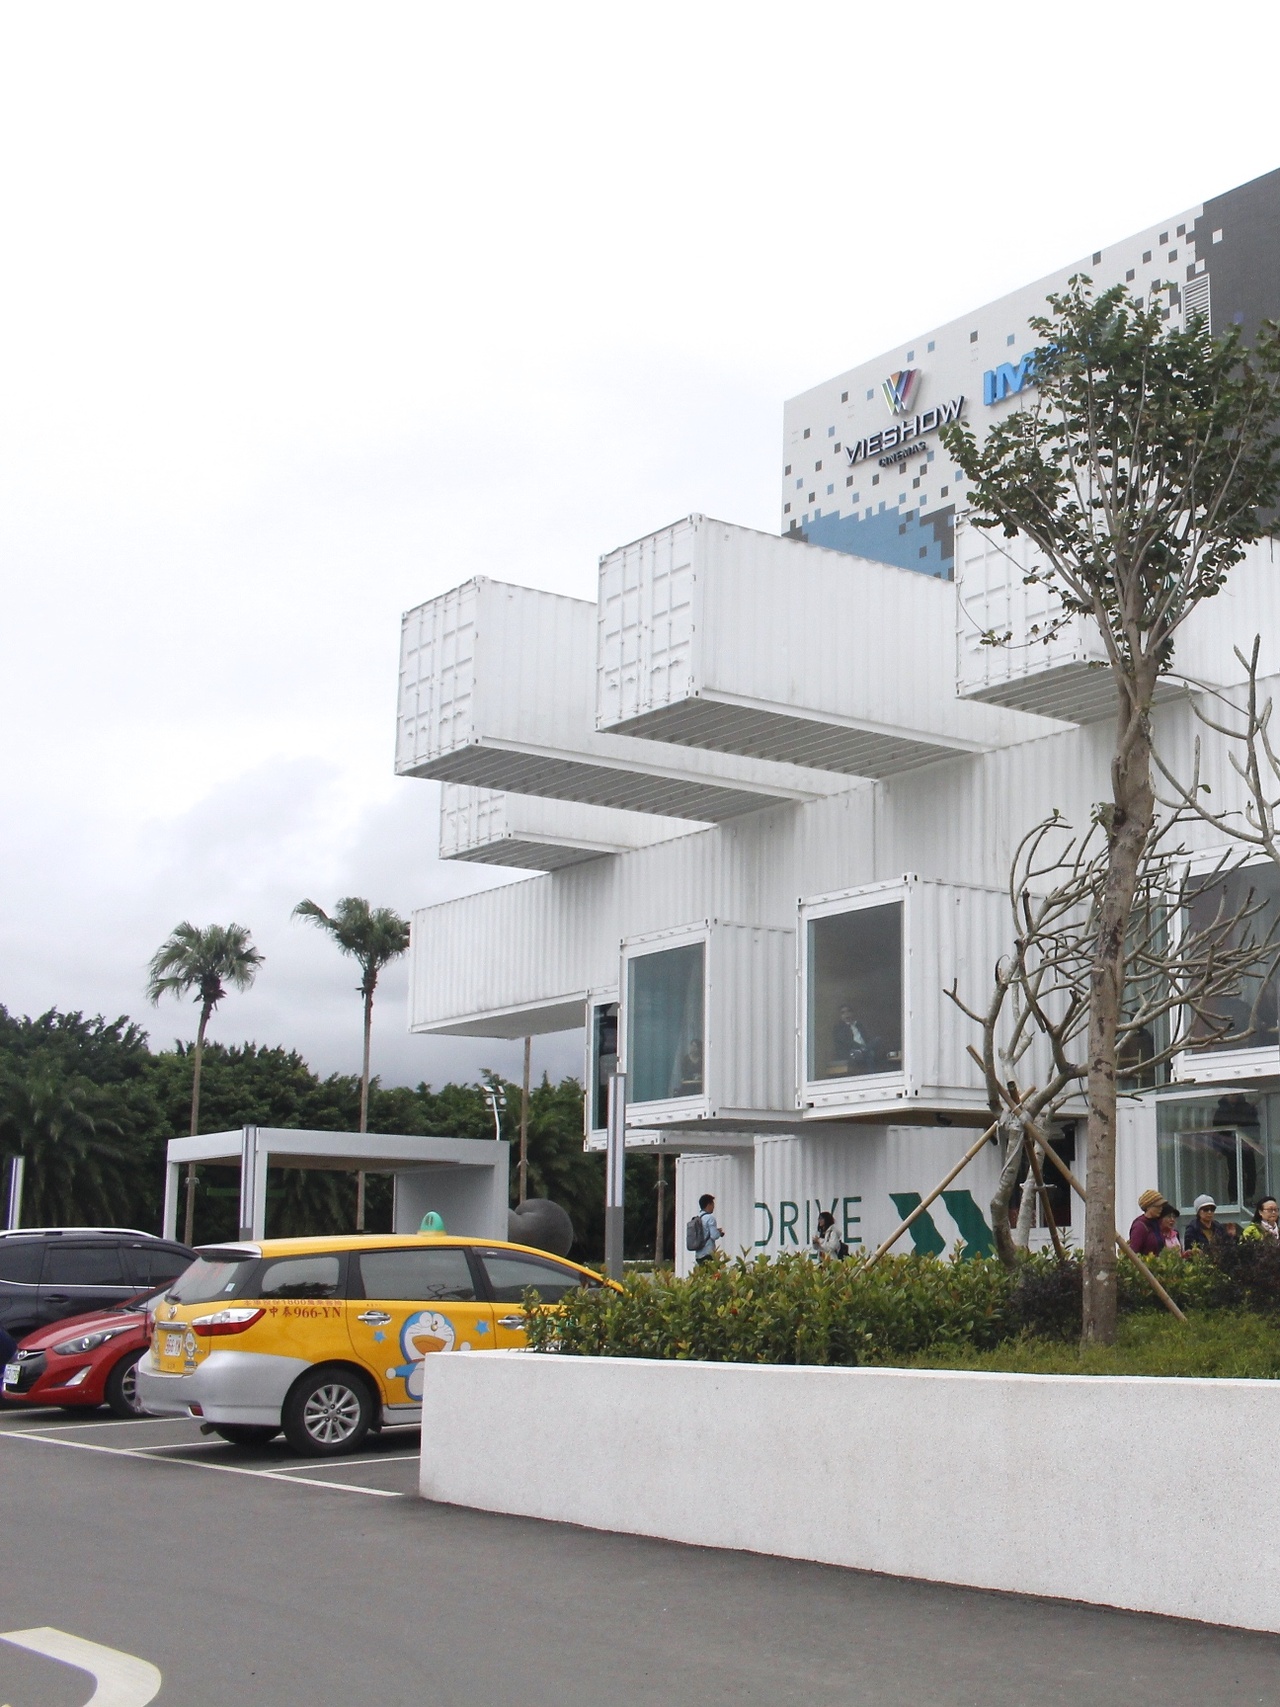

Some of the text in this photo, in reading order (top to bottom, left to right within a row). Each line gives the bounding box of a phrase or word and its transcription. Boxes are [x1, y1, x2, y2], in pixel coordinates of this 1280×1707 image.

[845, 395, 964, 465] VIESHOW
[878, 441, 927, 467] CINEMAS
[293, 1307, 341, 1319] 966-YN
